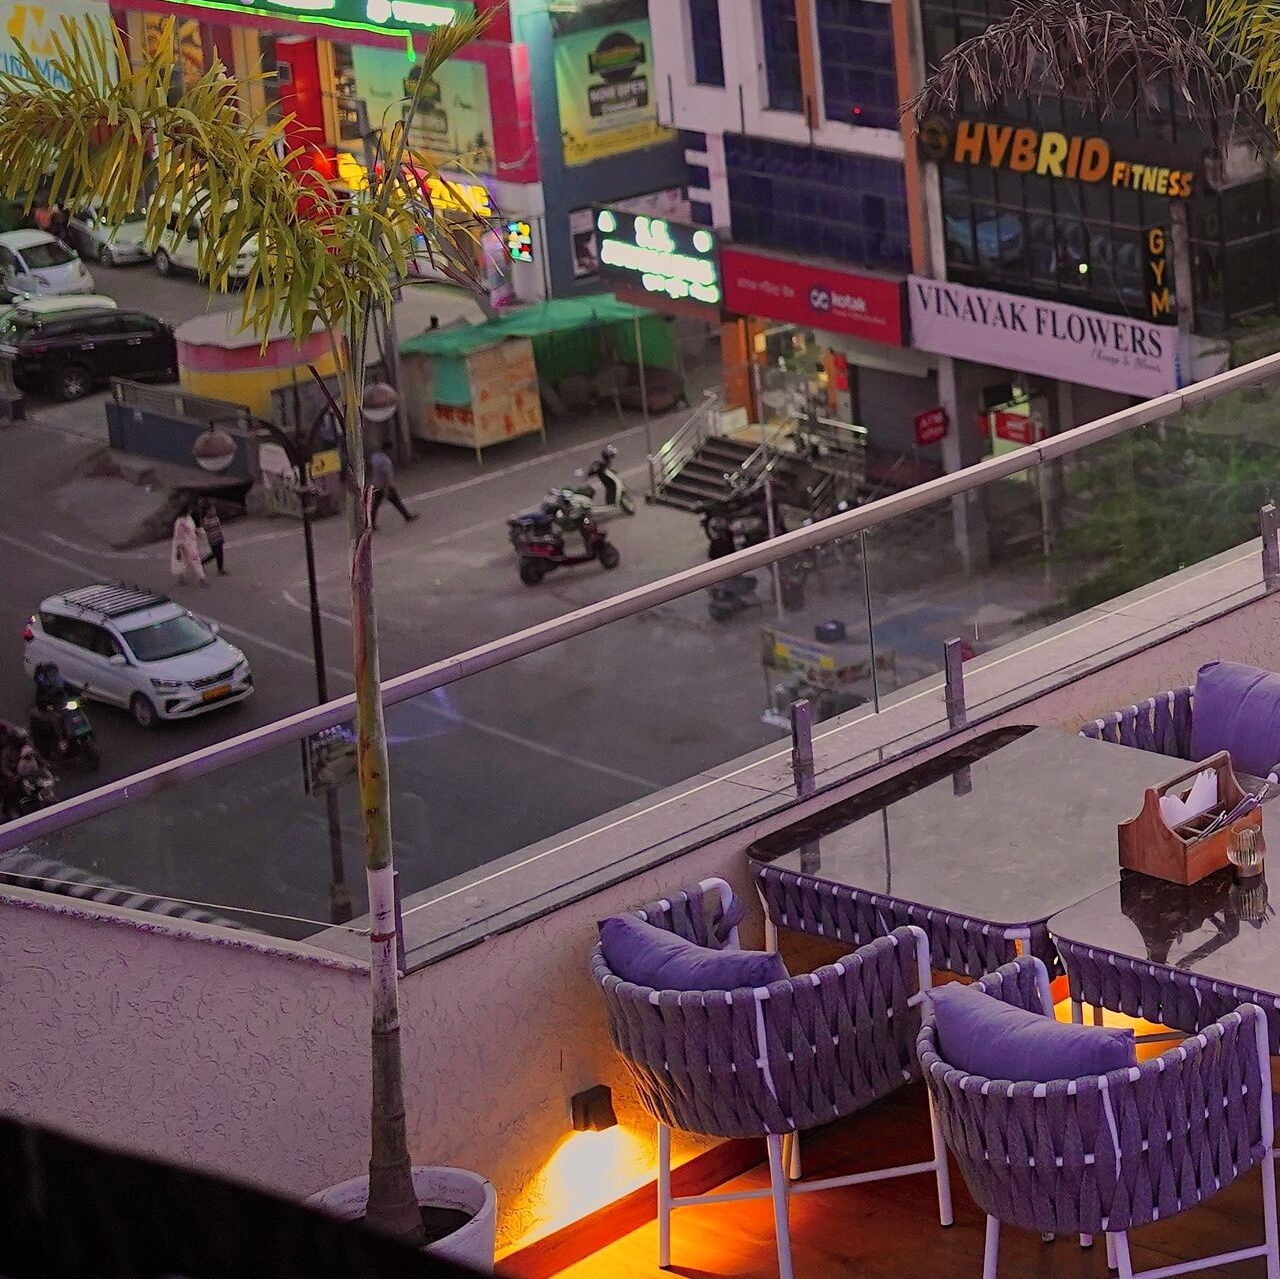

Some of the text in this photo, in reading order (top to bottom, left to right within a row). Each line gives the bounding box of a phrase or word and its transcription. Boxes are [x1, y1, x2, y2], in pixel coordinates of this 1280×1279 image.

[953, 121, 1194, 198] HYBRID FITNESS
[1149, 228, 1170, 317] GYM
[916, 283, 1163, 359] VINAYAK FLOWERS
